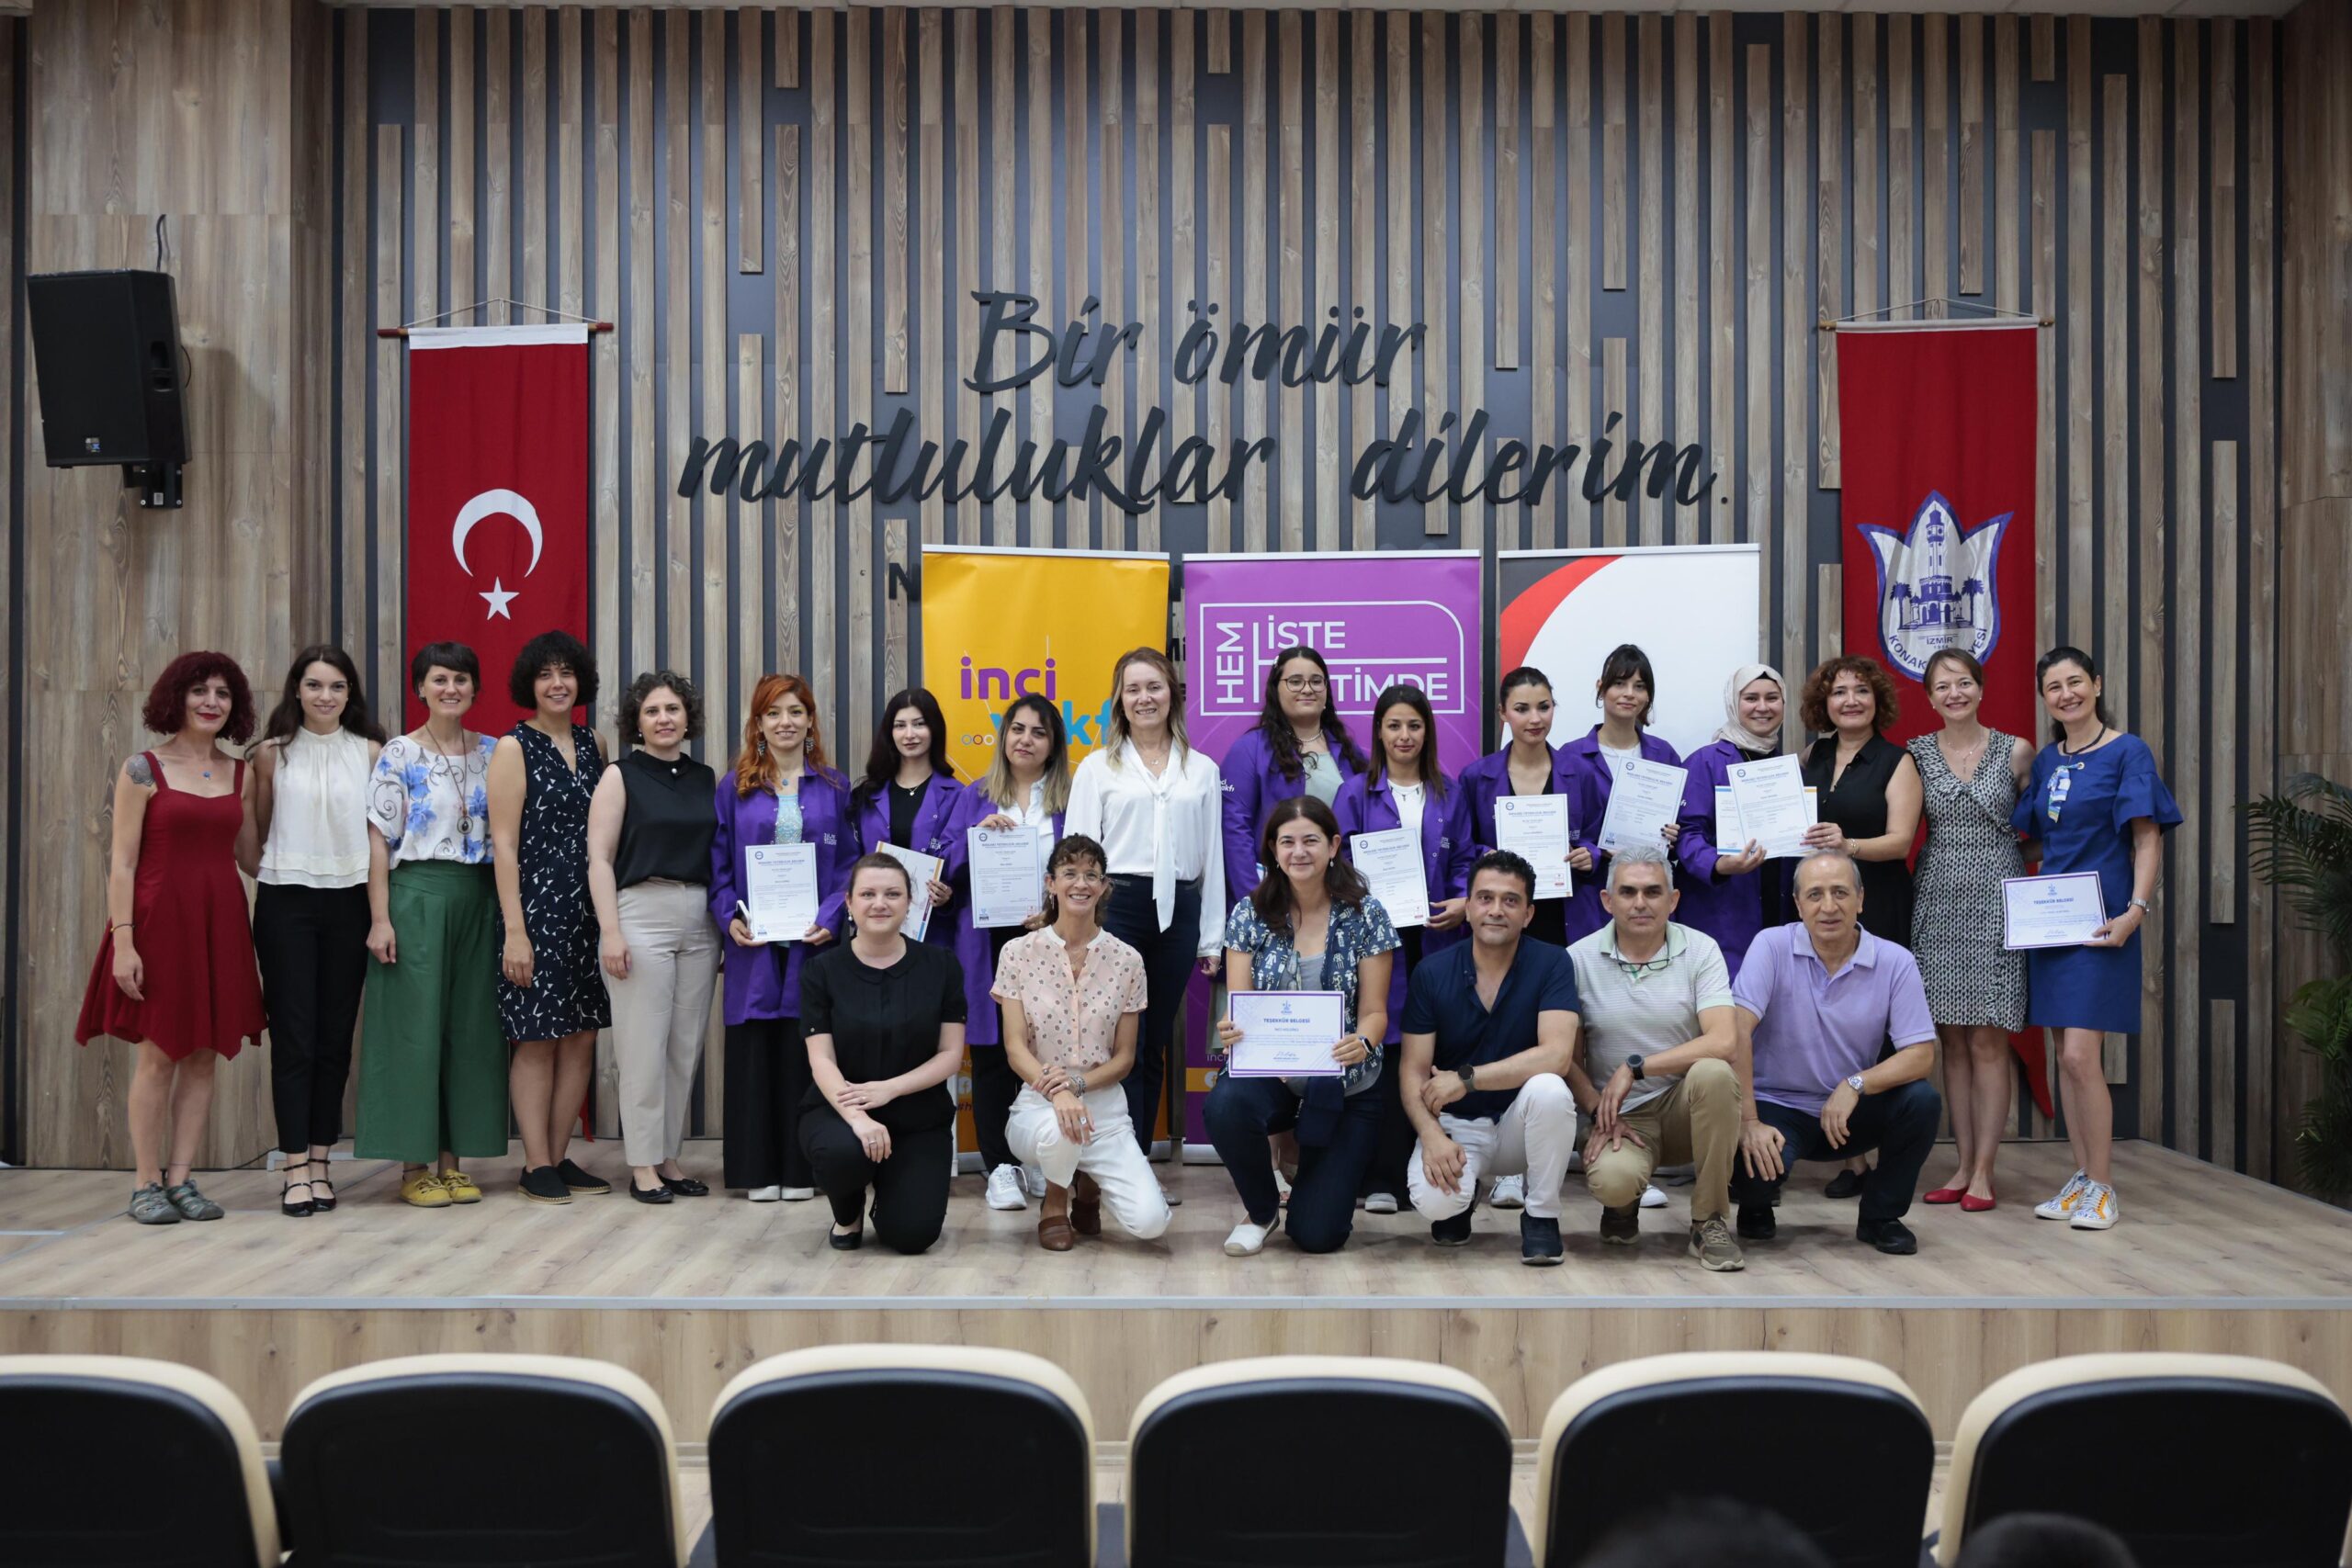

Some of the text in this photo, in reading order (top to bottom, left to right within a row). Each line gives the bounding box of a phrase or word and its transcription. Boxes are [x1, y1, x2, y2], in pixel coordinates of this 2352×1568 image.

[963, 290, 1428, 393] Bir ömür
[677, 404, 1728, 514] mutluluklar dilerim.
[960, 656, 1056, 701] inci
[1216, 622, 1244, 704] HEM
[1889, 635, 1928, 671] KONAK
